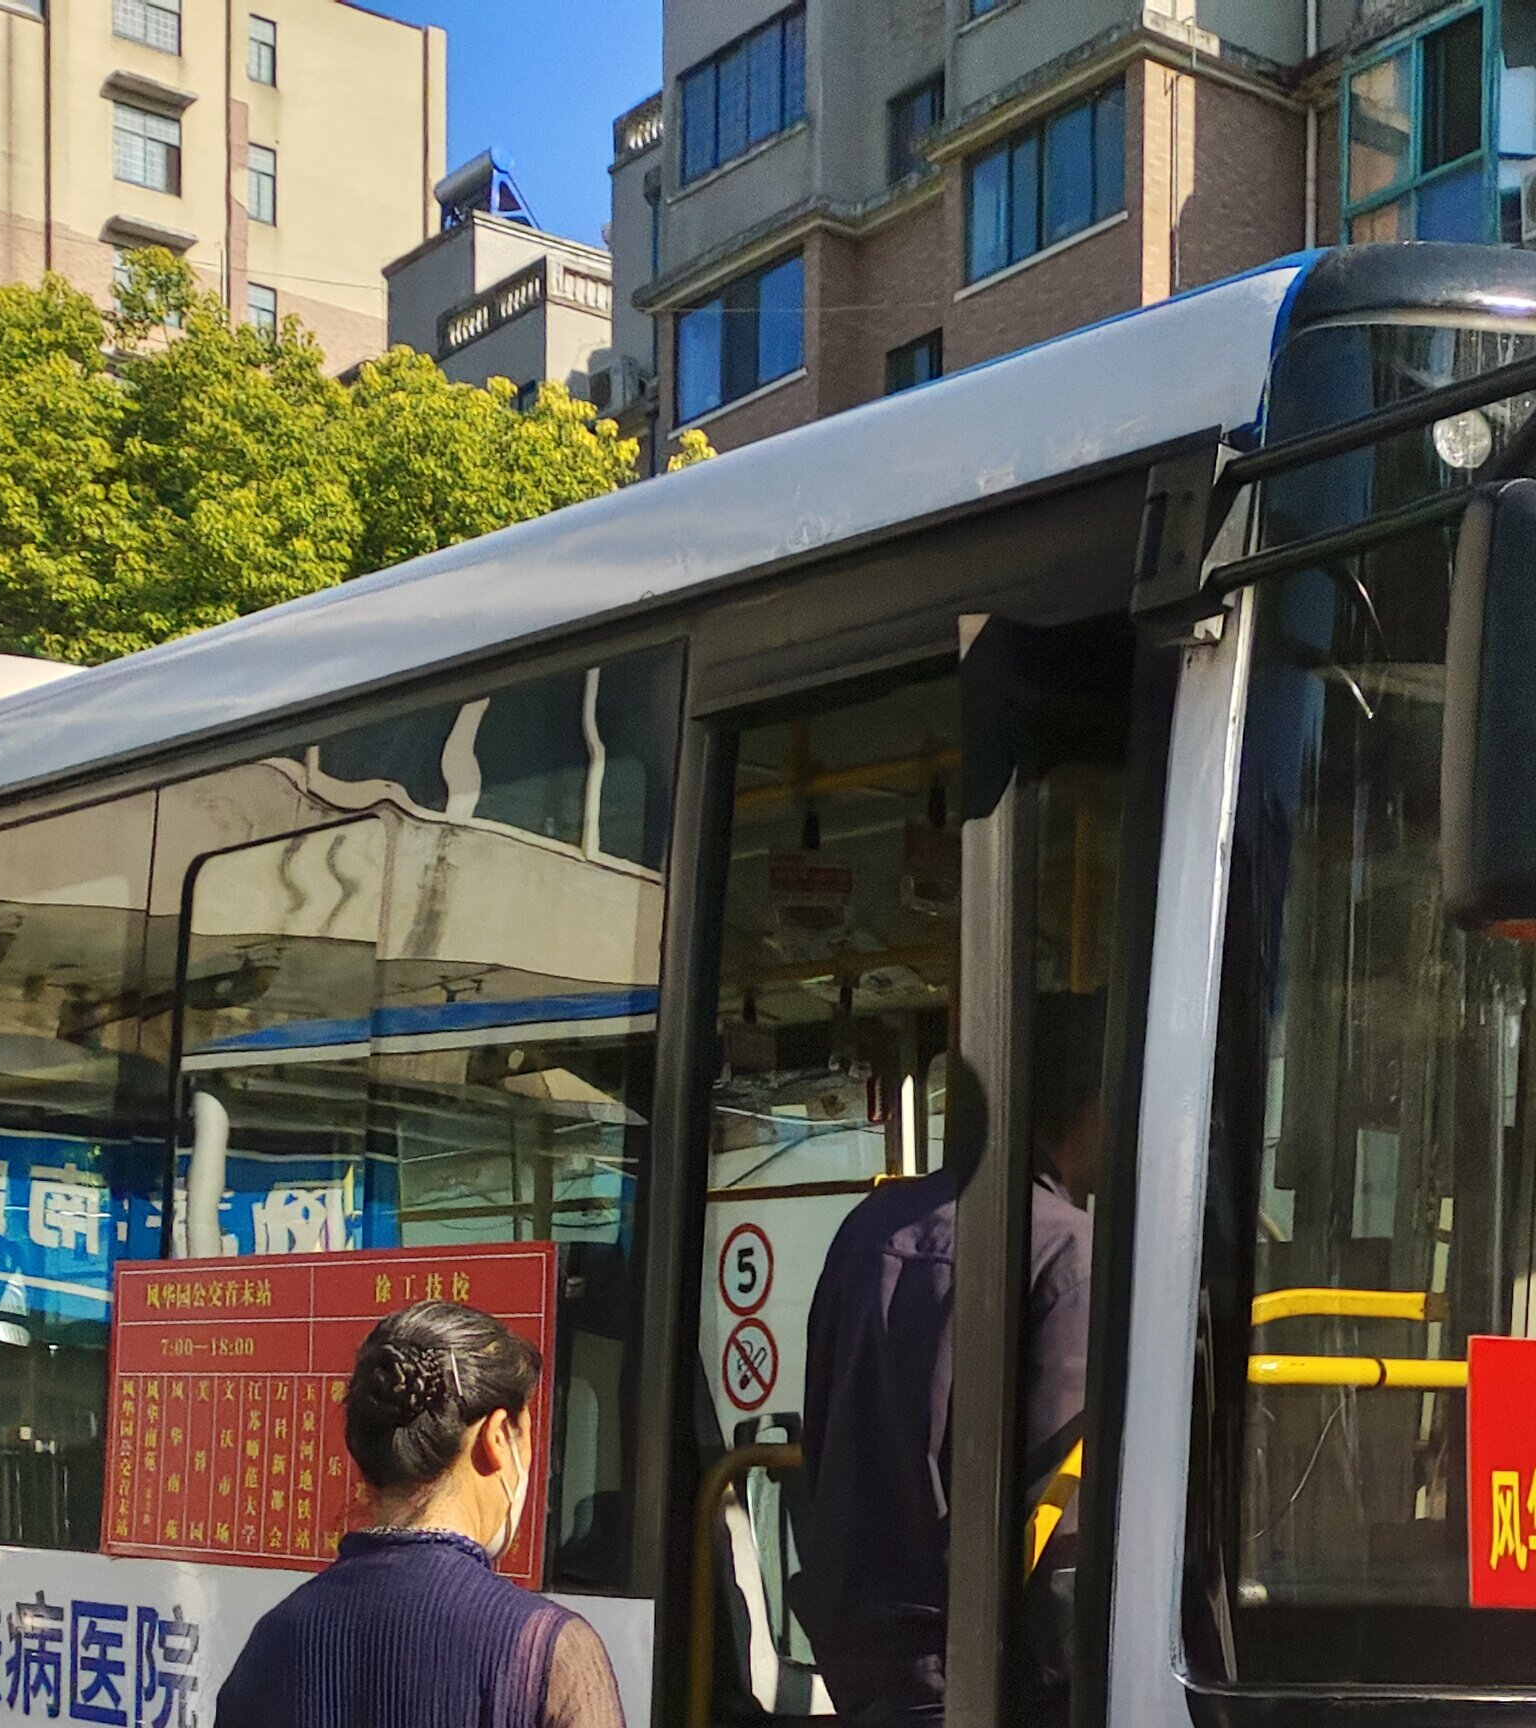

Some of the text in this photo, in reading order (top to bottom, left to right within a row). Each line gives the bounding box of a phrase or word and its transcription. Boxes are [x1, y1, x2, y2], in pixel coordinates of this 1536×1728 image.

[374, 1271, 471, 1303] 徐工技校
[737, 1247, 757, 1292] 5
[145, 1278, 272, 1309] 风华园公交首末站
[241, 1380, 263, 1544] 江苏师范大学
